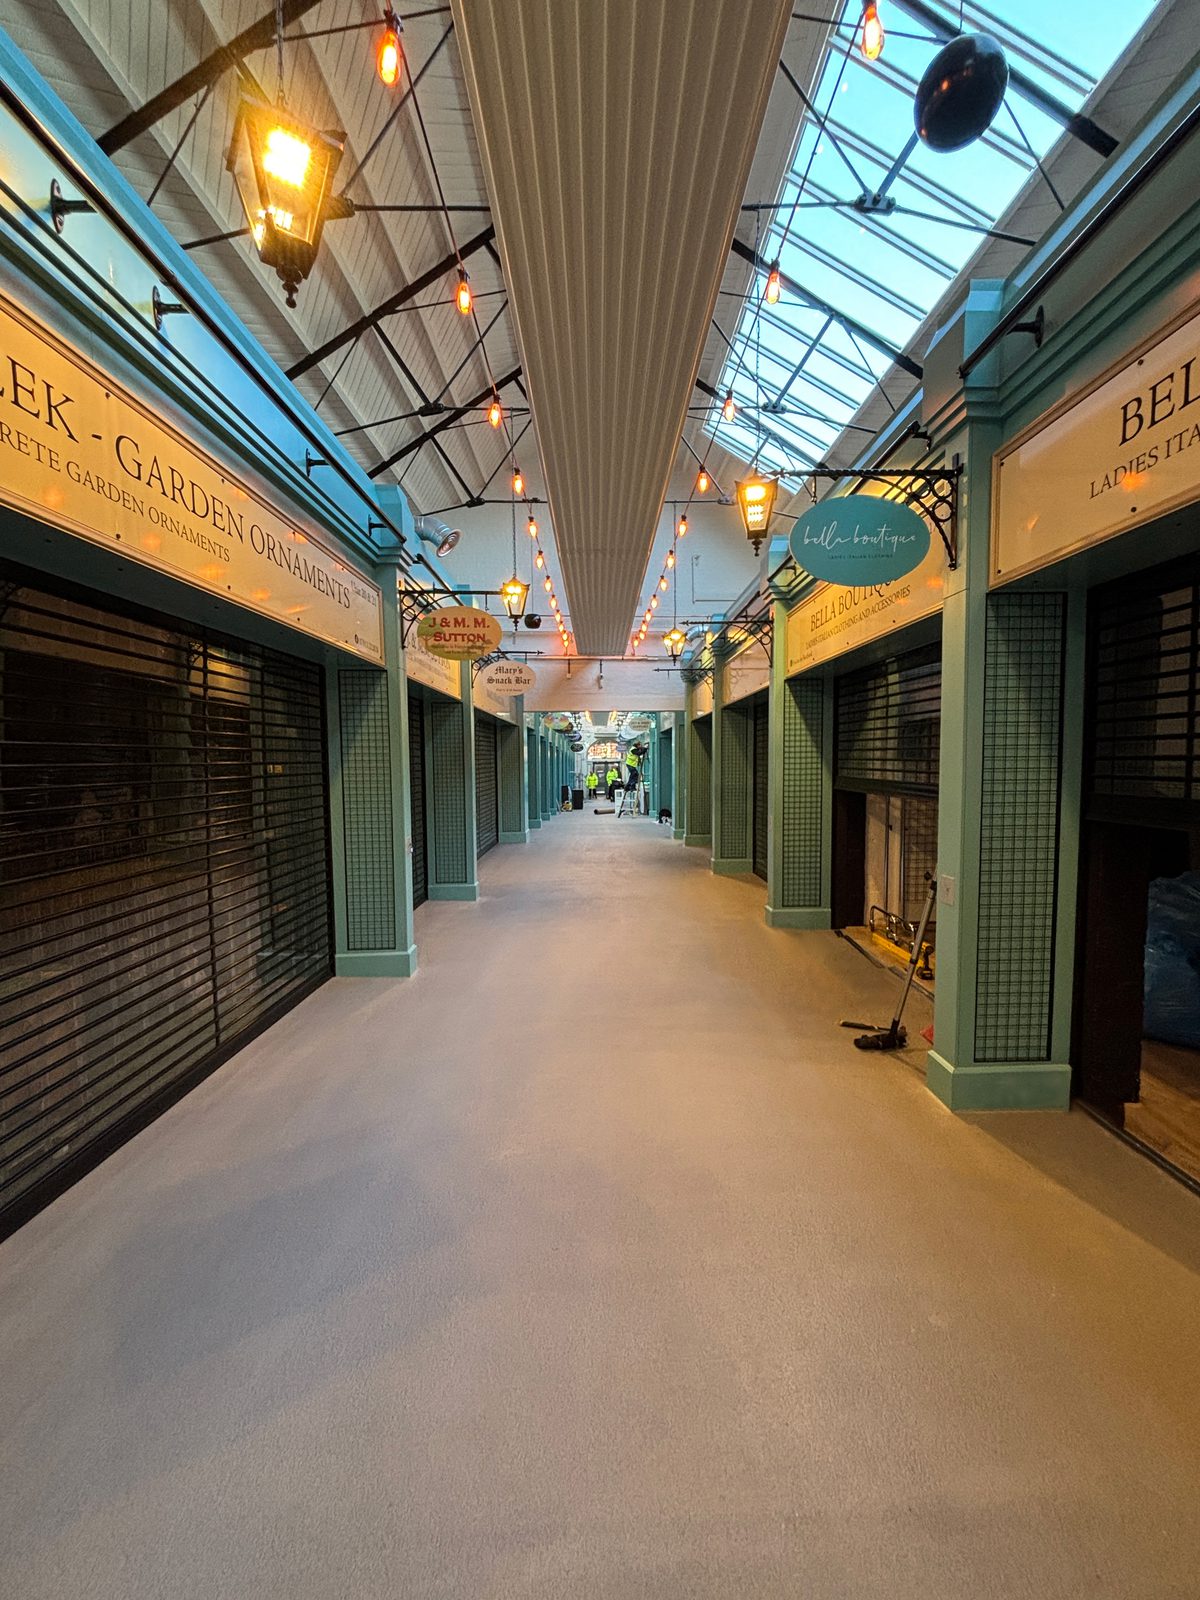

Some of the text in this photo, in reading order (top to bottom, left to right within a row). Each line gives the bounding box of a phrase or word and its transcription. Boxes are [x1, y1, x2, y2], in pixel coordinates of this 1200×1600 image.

[1118, 356, 1200, 447] BEL
[0, 354, 80, 444] EK
[115, 434, 244, 545] GARDEN
[250, 524, 351, 610] ORNAMENTS
[1089, 445, 1159, 500] LADIES
[66, 460, 145, 517] GARDEN
[148, 506, 231, 563] ORNAMENTS
[803, 520, 916, 553] bella boutique
[428, 617, 490, 629] J & M. M.
[810, 600, 837, 633] BELLA
[433, 631, 487, 643] SUTTON
[486, 675, 532, 685] Snack Bar
[494, 666, 524, 676] Mary's
